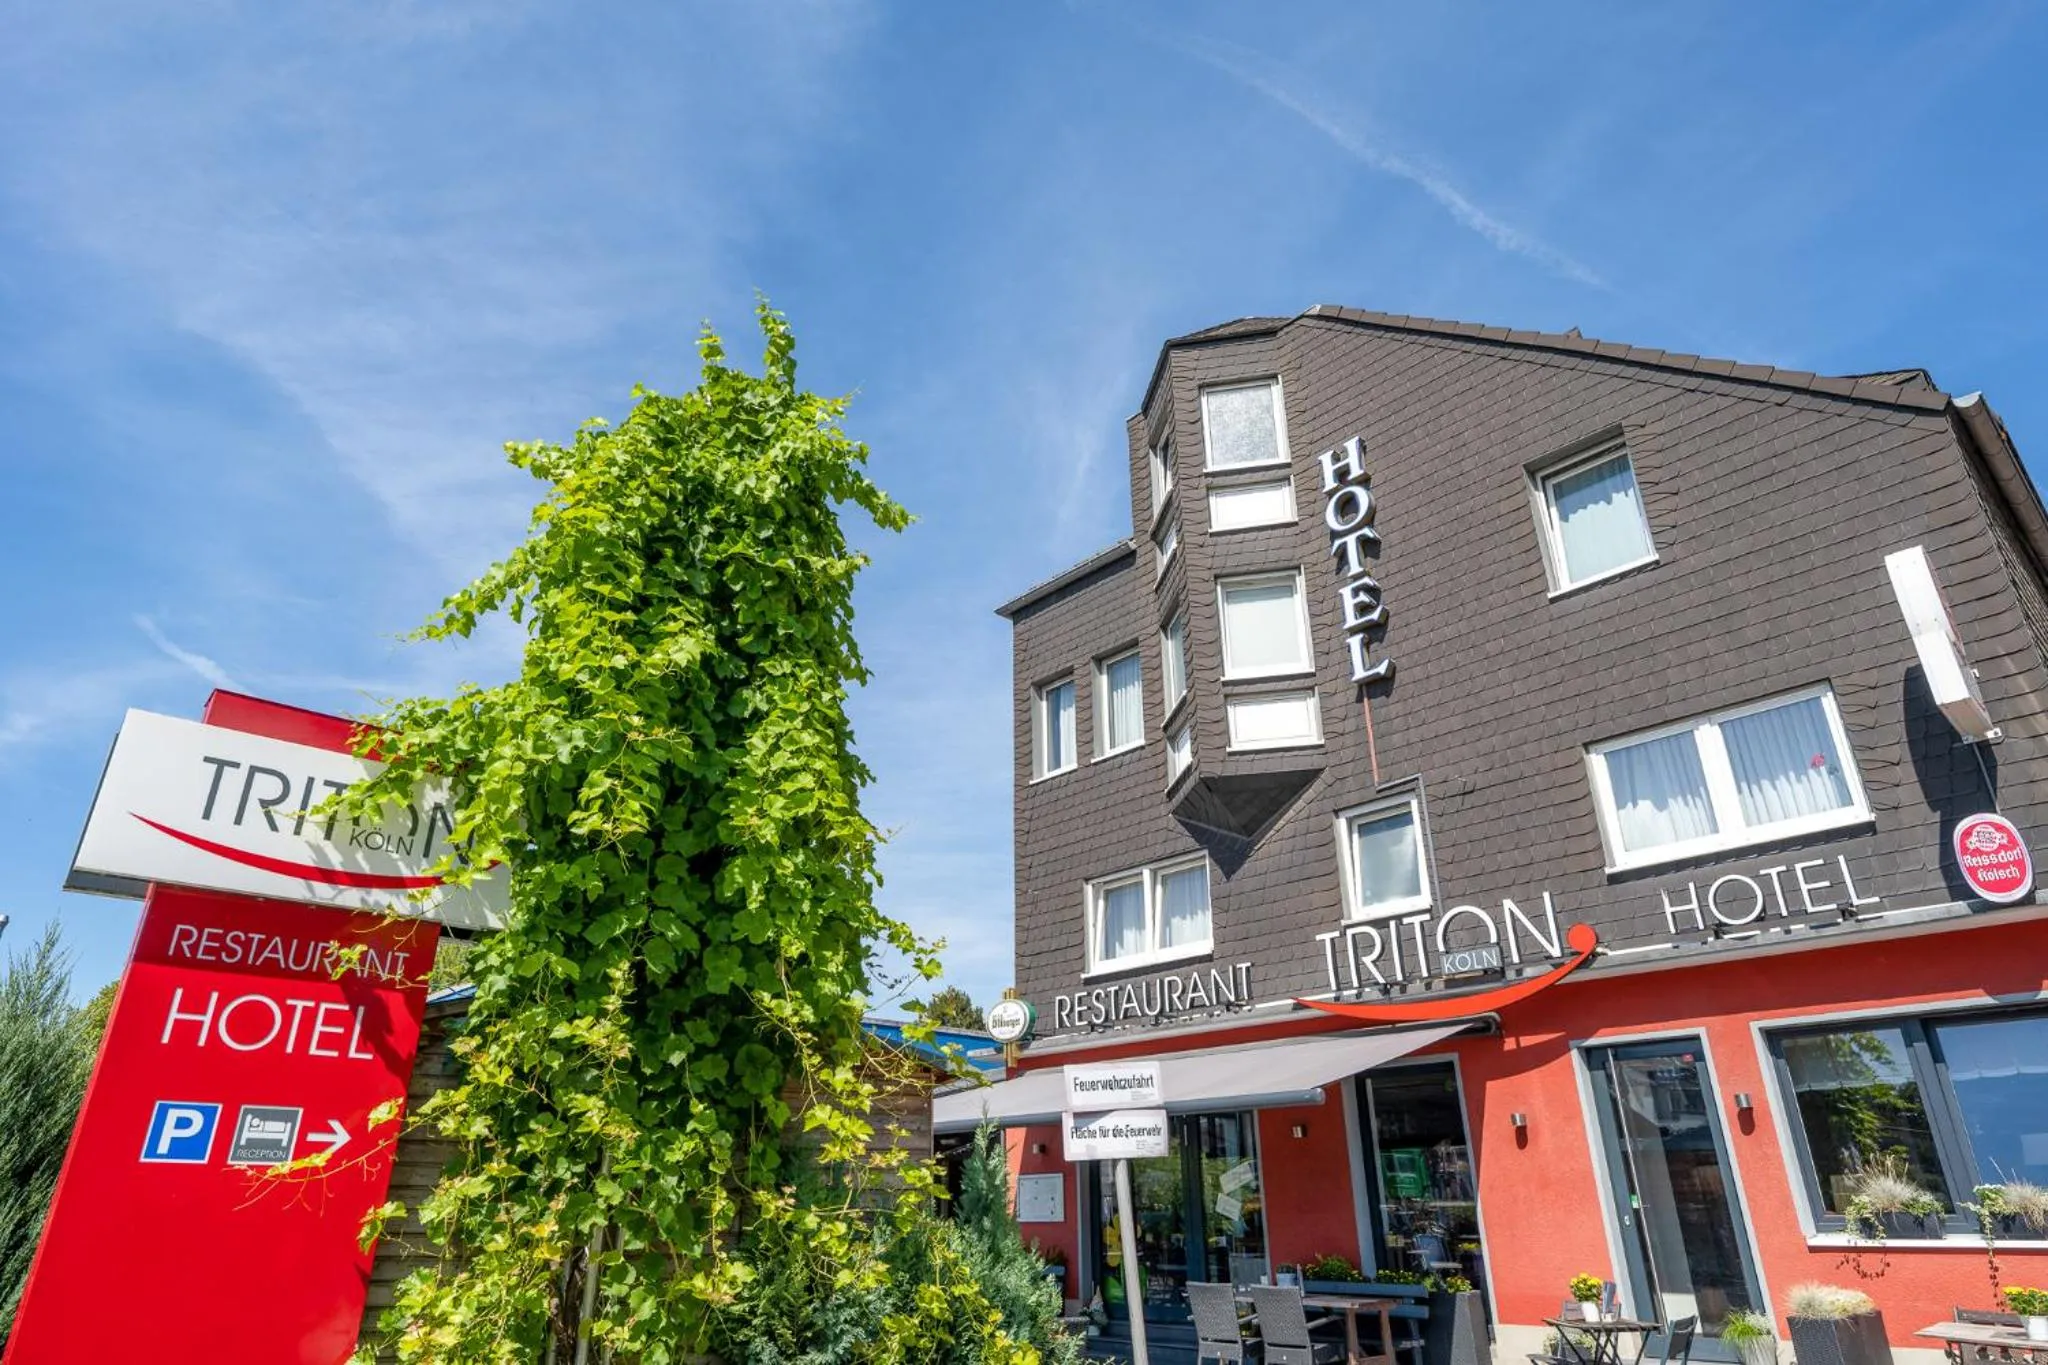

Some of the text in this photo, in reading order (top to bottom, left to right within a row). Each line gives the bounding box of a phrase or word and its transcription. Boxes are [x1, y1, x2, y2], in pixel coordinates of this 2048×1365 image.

[1319, 435, 1396, 685] HOTEL
[349, 826, 414, 857] KÖLN
[1963, 847, 2022, 867] Reissdorf
[1660, 855, 1881, 934] HOTEL
[1315, 891, 1562, 991] TRITON
[1442, 951, 1498, 974] KÖLN
[160, 987, 374, 1060] HOTEL
[1055, 962, 1252, 1029] RESTAURANT
[156, 1107, 204, 1155] P
[237, 1148, 287, 1159] RECEPTION
